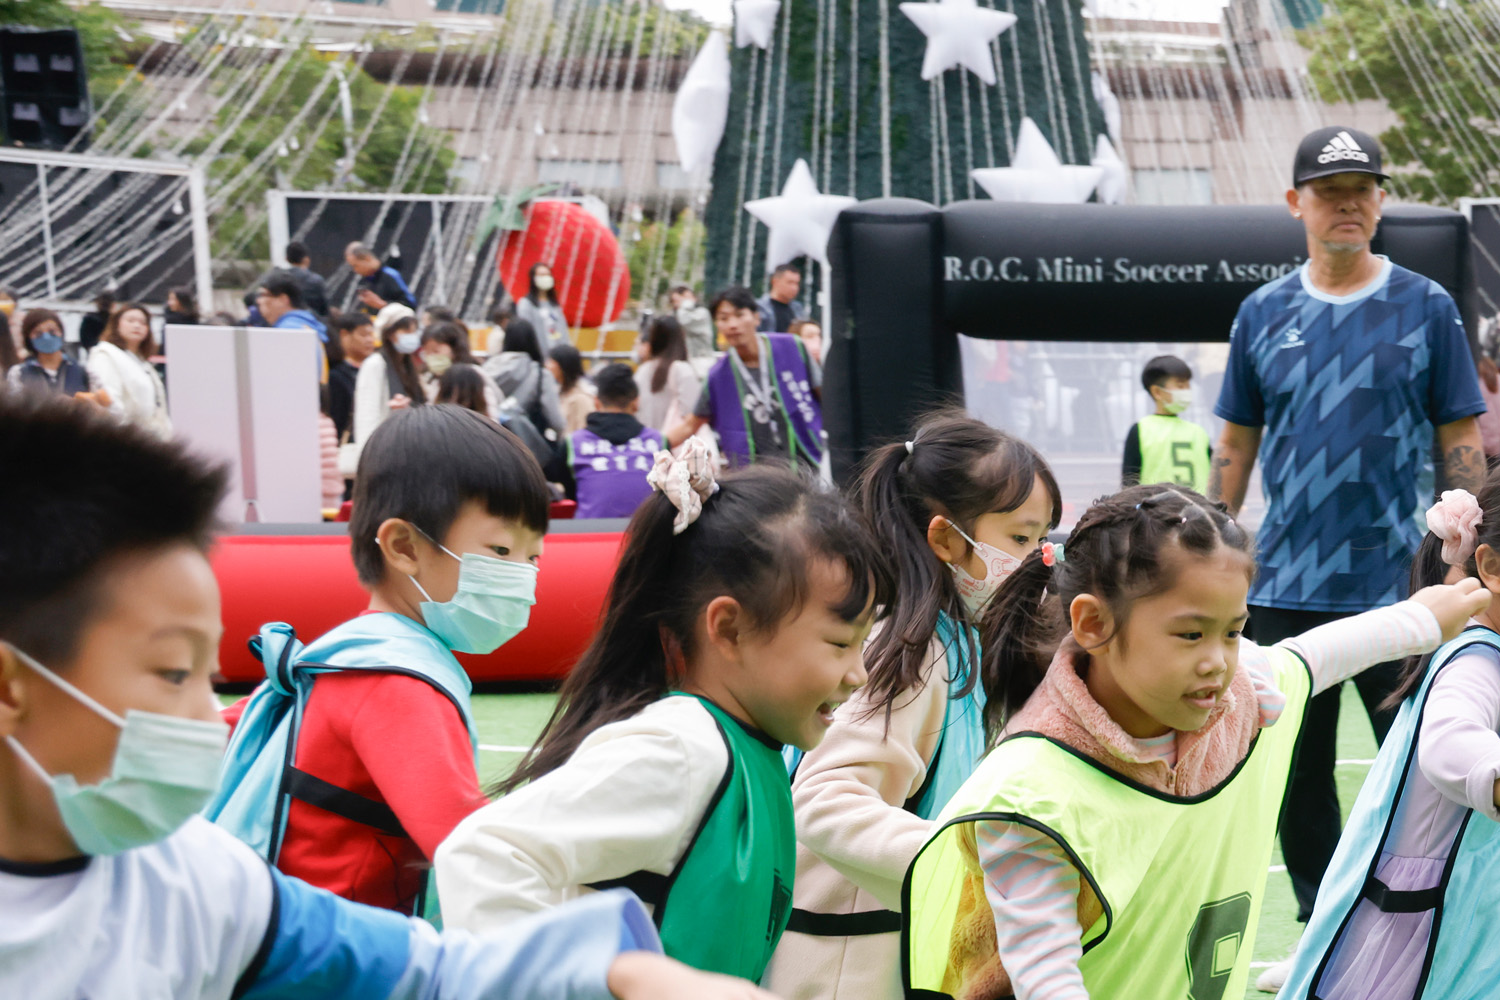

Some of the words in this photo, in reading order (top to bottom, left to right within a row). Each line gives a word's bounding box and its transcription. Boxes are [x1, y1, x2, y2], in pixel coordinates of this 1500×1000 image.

[1317, 150, 1370, 164] adidas
[944, 256, 1029, 282] R.O.C.
[1037, 256, 1209, 283] Mini-Soccer
[1170, 442, 1196, 487] 5
